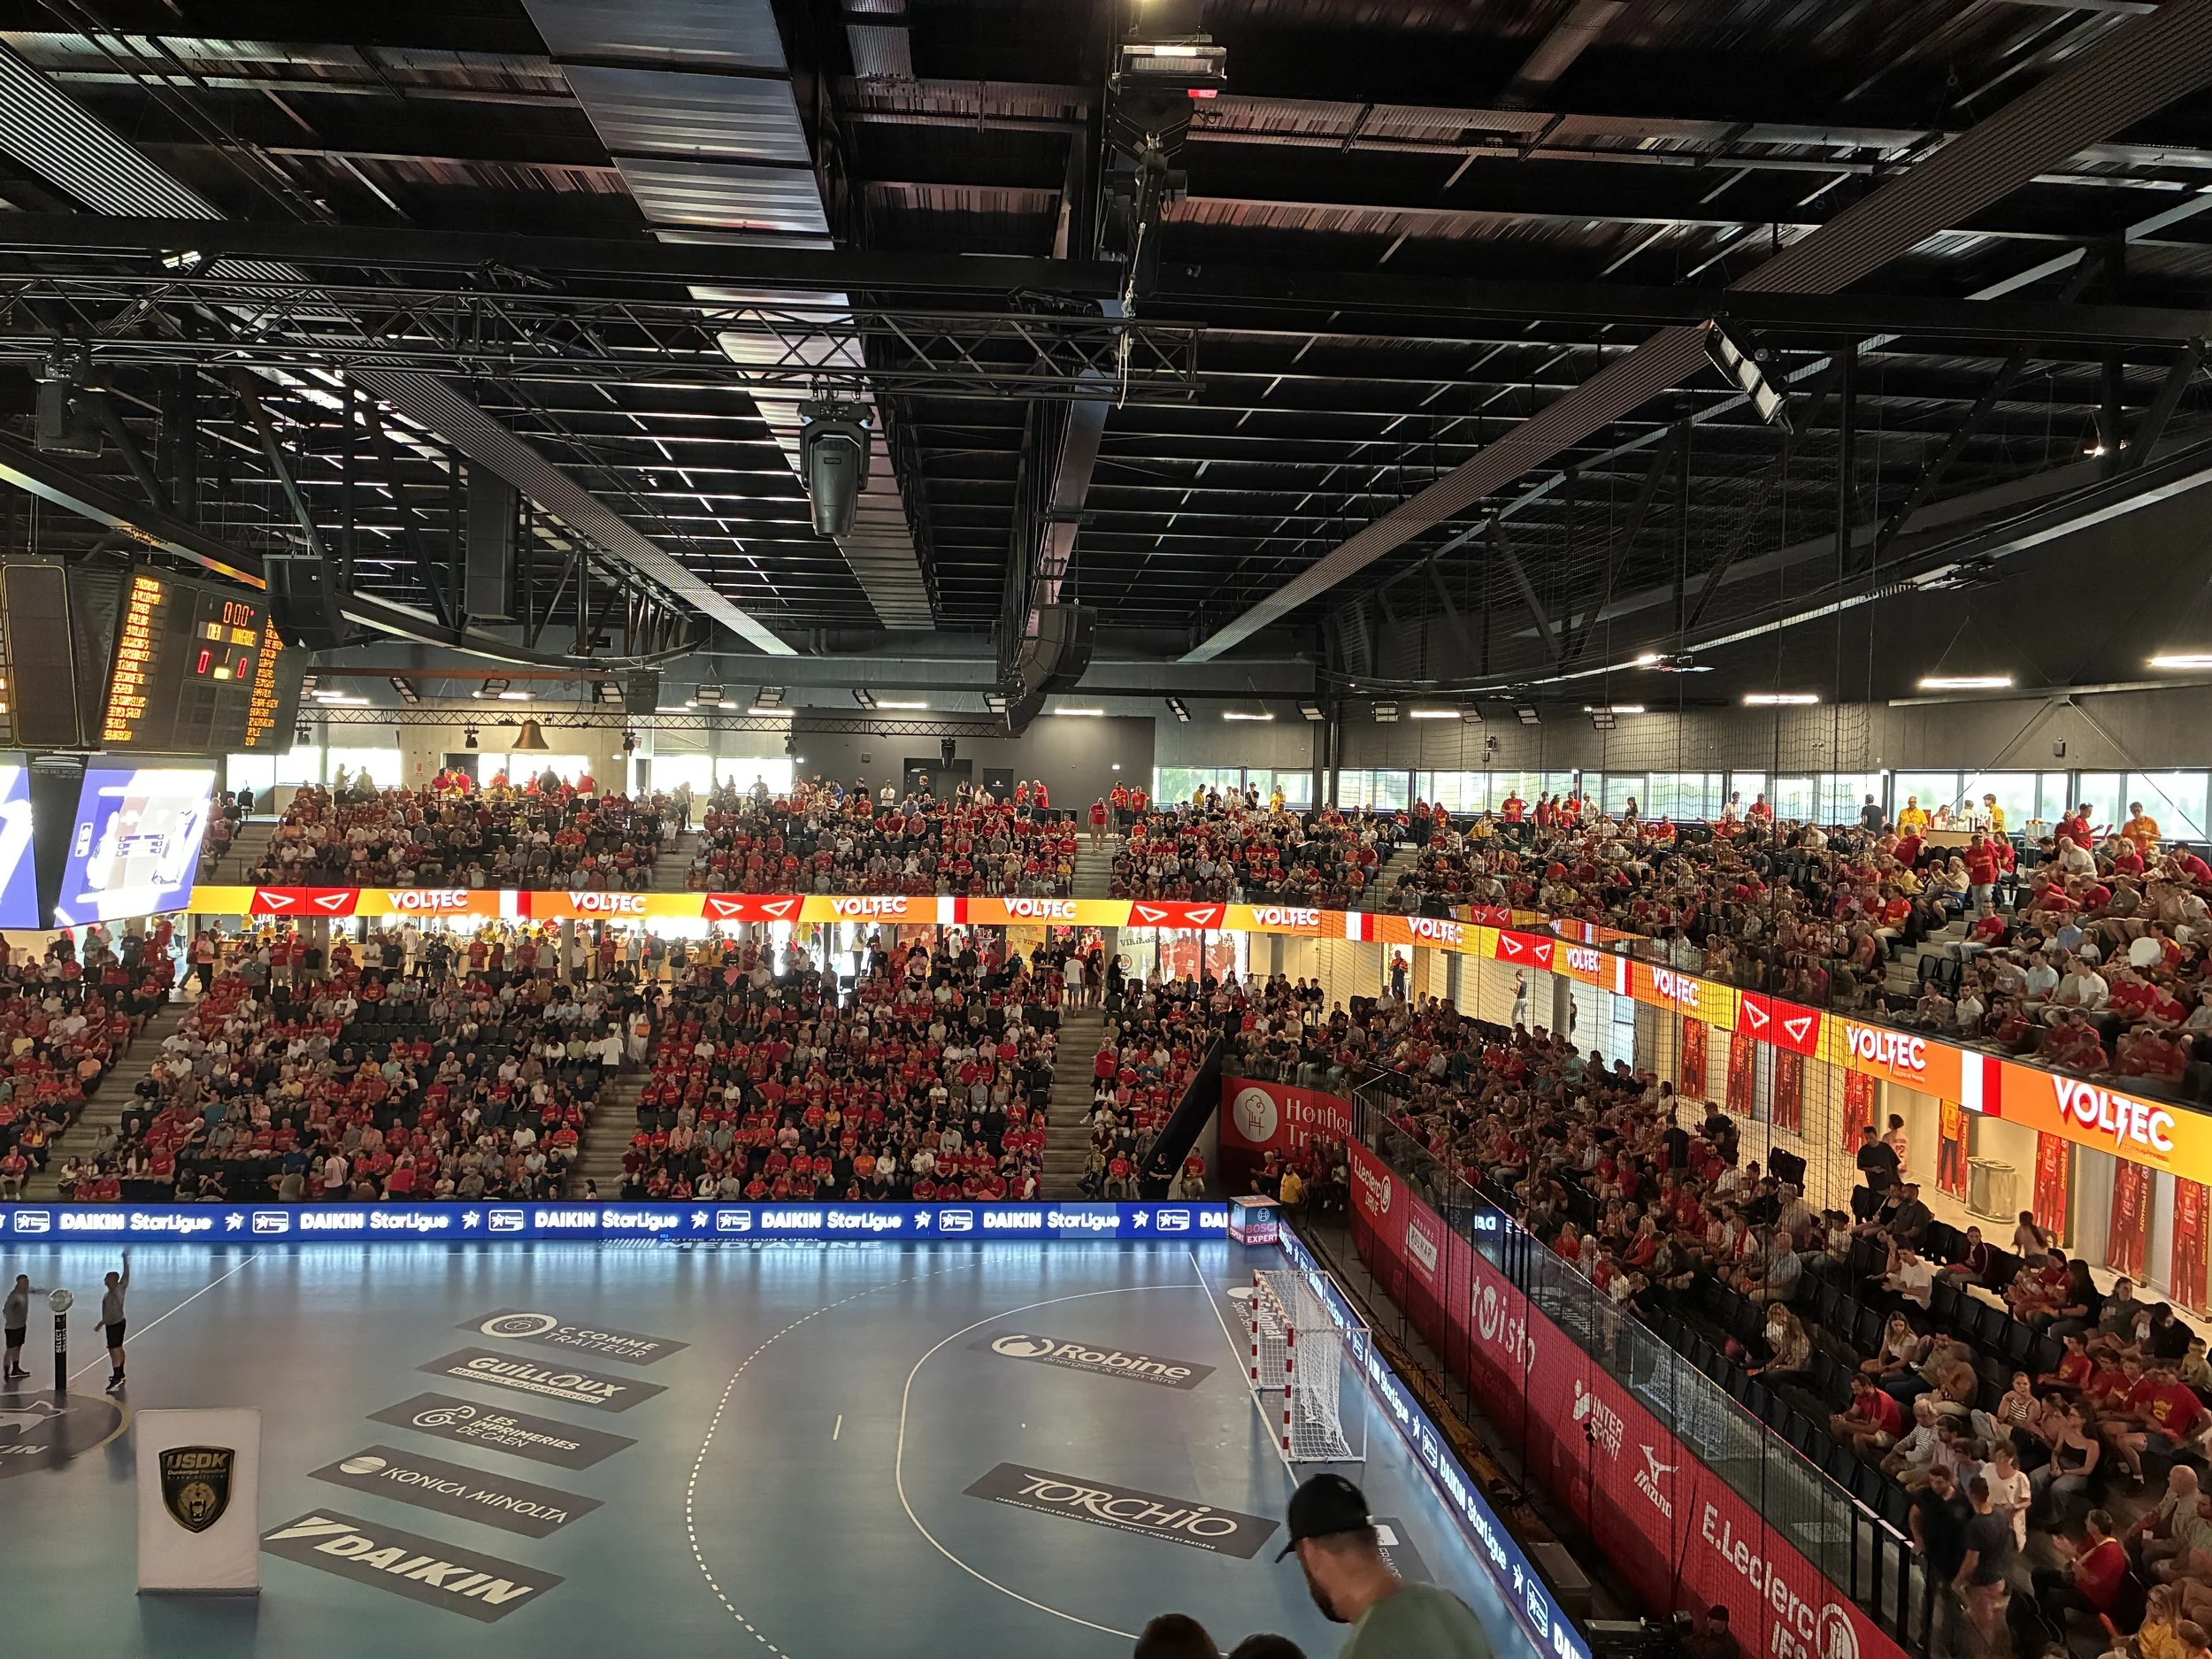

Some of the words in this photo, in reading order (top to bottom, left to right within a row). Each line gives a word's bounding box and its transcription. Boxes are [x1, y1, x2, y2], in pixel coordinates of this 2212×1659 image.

[388, 890, 467, 913] VOLTEC
[569, 892, 646, 916] VOLTEC
[831, 896, 907, 921] VOLTEC
[1003, 898, 1076, 921] VOLTEC
[1252, 907, 1318, 932] VOLTEC
[1847, 1025, 1926, 1075] VOLTEC
[2052, 1075, 2175, 1148] VOLTEC
[60, 1213, 124, 1230] DAIKIN
[130, 1212, 211, 1233] StarLigue
[300, 1212, 363, 1229] DAIKIN
[370, 1211, 449, 1232] StarLigue
[534, 1212, 595, 1228] DAIKIN
[602, 1211, 678, 1231] StarLigue
[762, 1212, 820, 1228] DAIKIN
[827, 1211, 902, 1231] StarLigue
[983, 1212, 1041, 1228] DAIKIN
[1048, 1211, 1120, 1231] StarLigue
[1247, 1233, 1278, 1243] EXPERT
[545, 1333, 646, 1357] TRAITEUR
[578, 1331, 660, 1350] COMME
[1052, 1344, 1192, 1379] Robine
[483, 1415, 518, 1426] LES
[1594, 1396, 1624, 1440] INTER
[456, 1426, 483, 1437] DE
[481, 1432, 529, 1448] CAEN
[469, 1420, 580, 1450] IMPRIMERIES
[1590, 1422, 1622, 1462] SPORT
[166, 1453, 228, 1469] USDK
[380, 1467, 465, 1496] KONICA
[466, 1491, 568, 1525] MINOLTA
[1440, 1454, 1466, 1511] DAIKIN
[1468, 1496, 1507, 1570] StarLigue
[314, 1534, 534, 1605] DAIKIN
[1702, 1502, 1814, 1640] E.Leclerc
